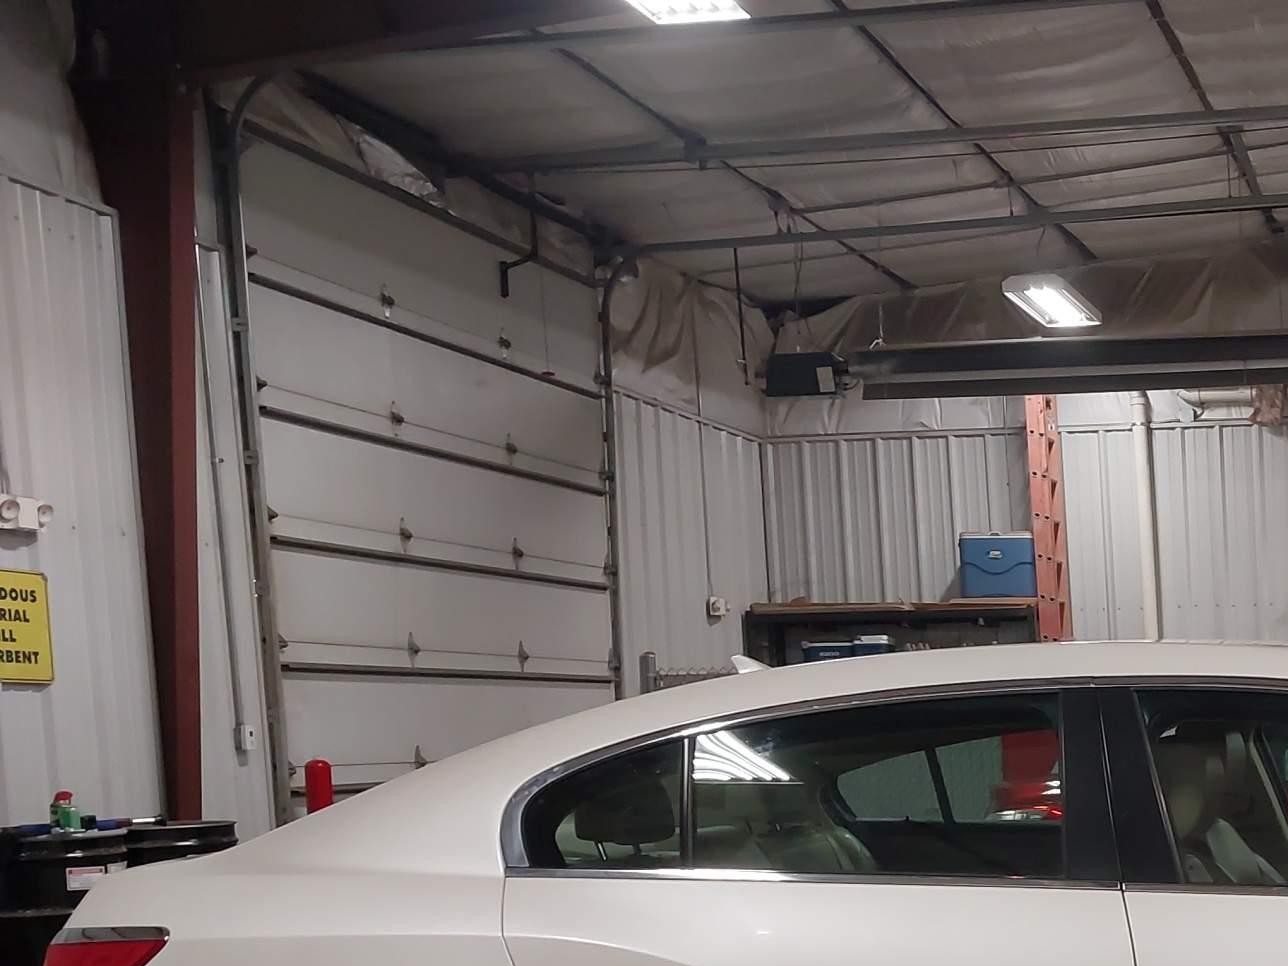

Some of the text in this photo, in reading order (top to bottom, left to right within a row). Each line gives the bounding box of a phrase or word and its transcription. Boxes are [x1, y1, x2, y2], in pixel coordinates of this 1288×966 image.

[0, 587, 37, 603] DOUS
[0, 608, 30, 623] RIAL
[0, 629, 16, 643] LL
[0, 650, 39, 664] RBENT
